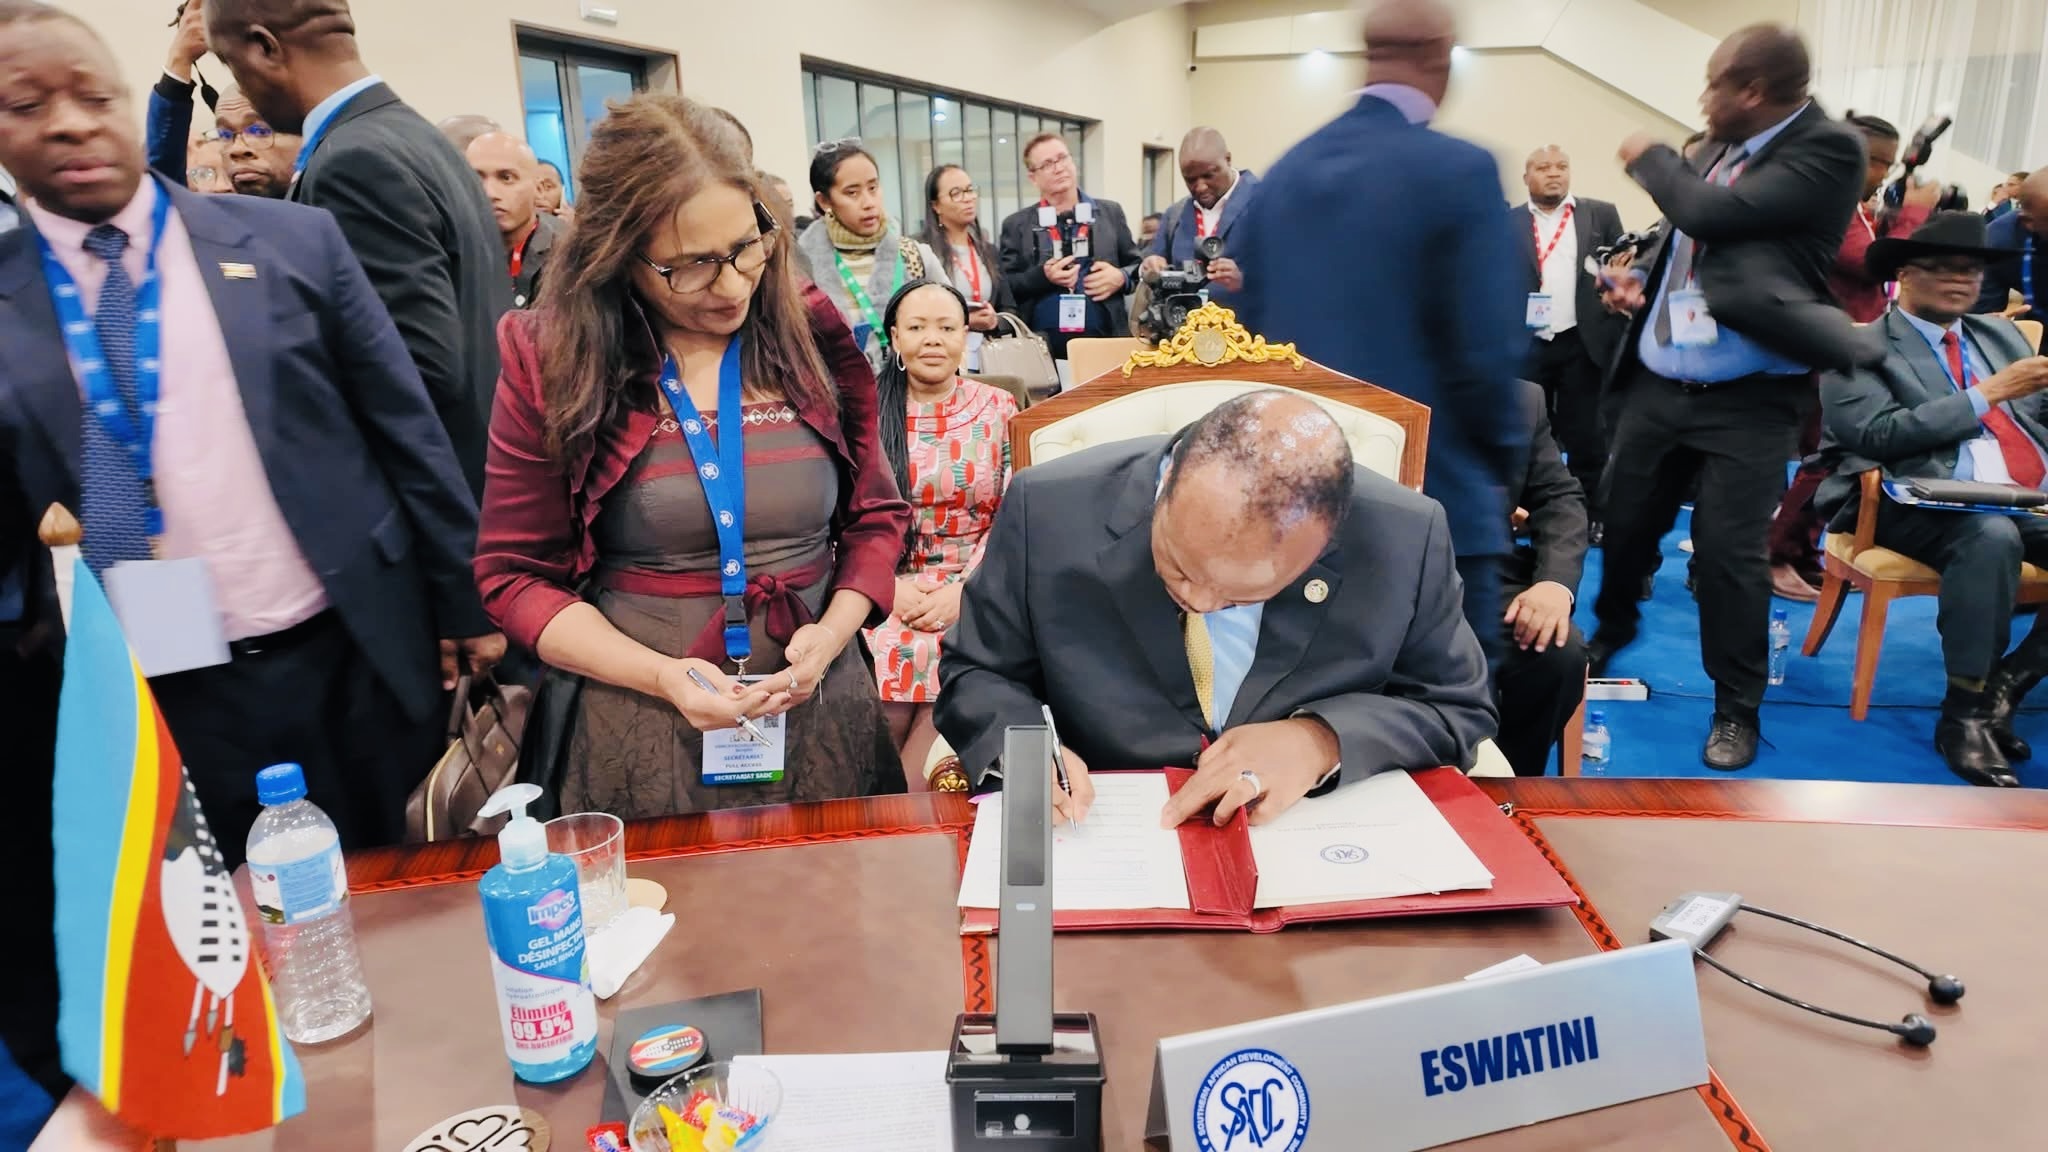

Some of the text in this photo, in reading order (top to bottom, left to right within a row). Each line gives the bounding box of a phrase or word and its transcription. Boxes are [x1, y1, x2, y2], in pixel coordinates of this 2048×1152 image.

[714, 773, 754, 782] SECRETARIAT
[528, 936, 553, 949] GEL
[534, 958, 557, 971] SANS
[1420, 1016, 1599, 1097] ESWATINI
[1197, 1052, 1307, 1136] SOUTHERN AFRICAN DEVELOPMENT COMMUNITY
